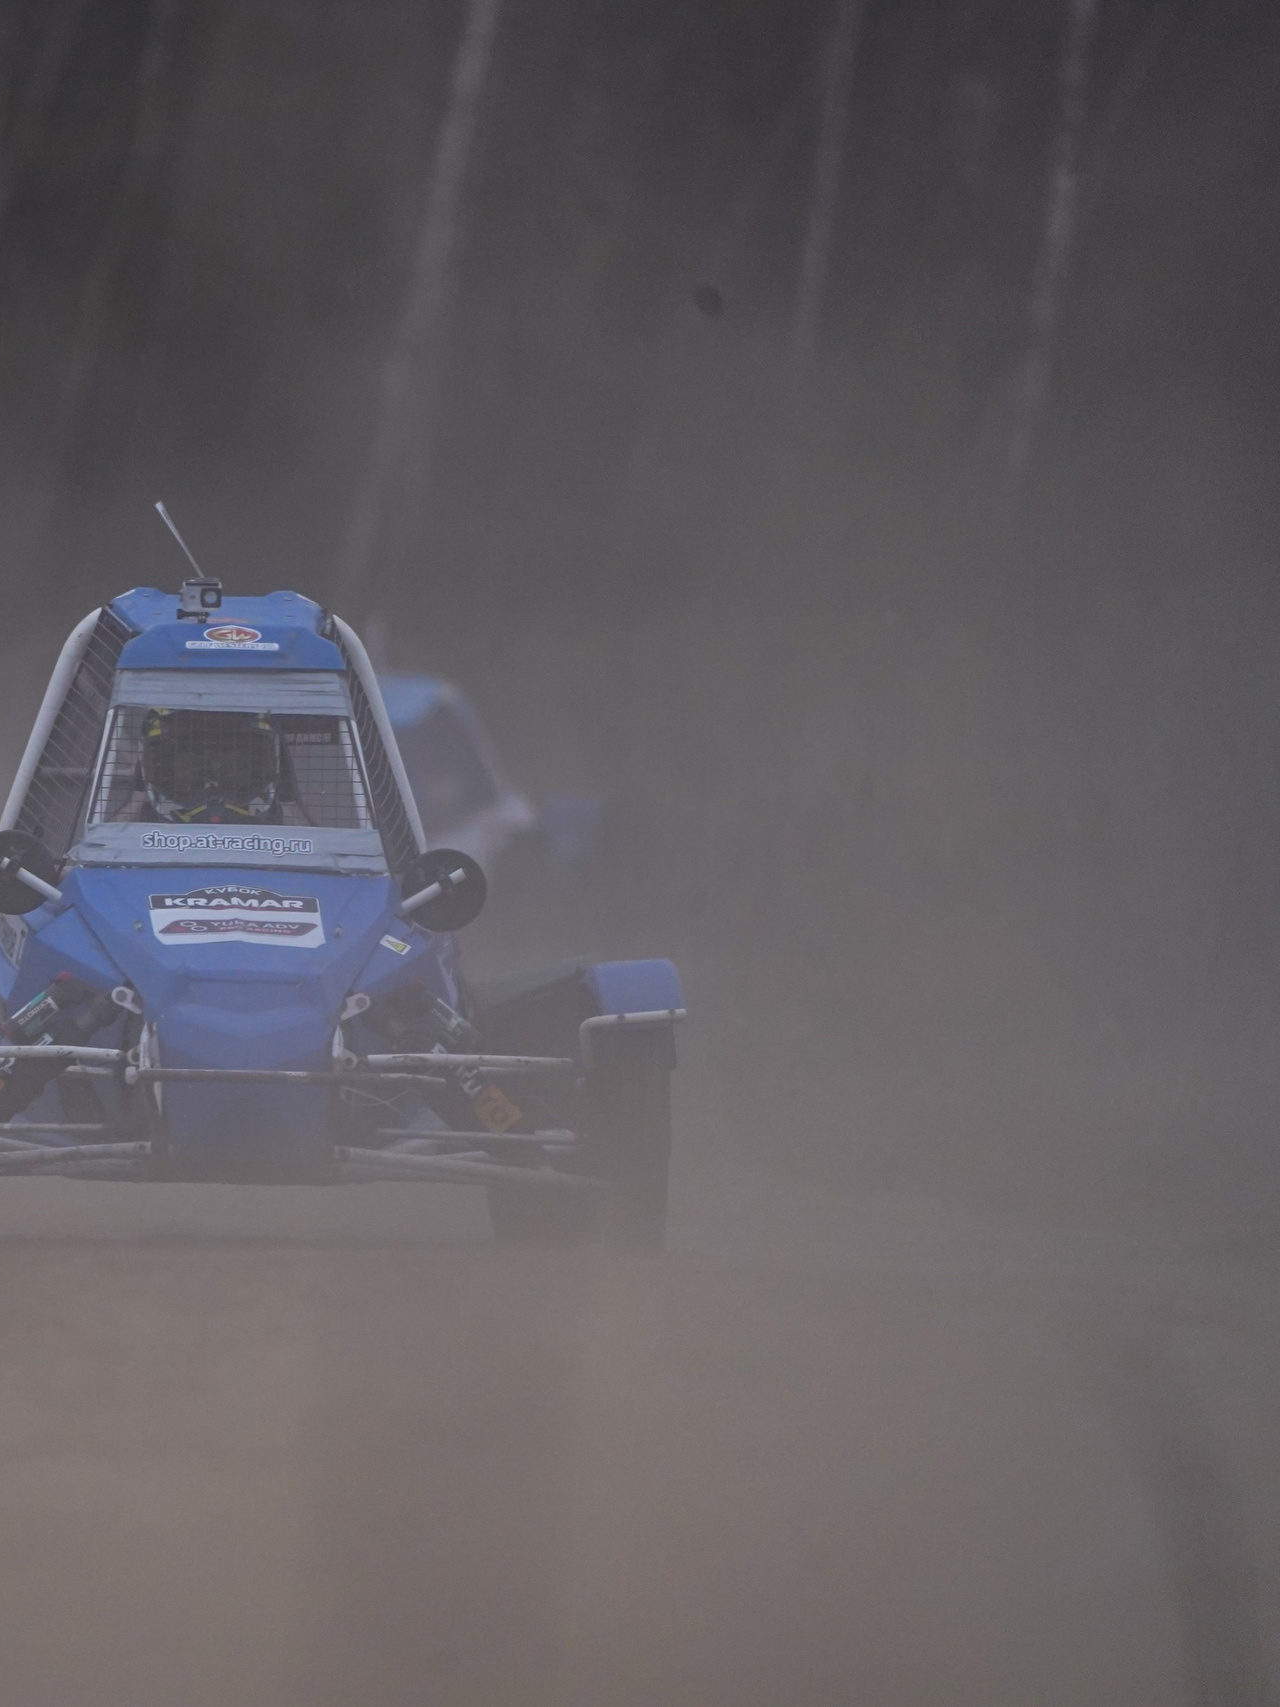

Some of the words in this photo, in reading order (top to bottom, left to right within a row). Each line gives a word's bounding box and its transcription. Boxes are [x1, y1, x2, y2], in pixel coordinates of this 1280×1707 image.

[142, 830, 313, 855] shop.at-racing.ru
[205, 886, 262, 896] КУБОК
[164, 897, 304, 909] KRAMAR
[263, 922, 300, 930] ADV
